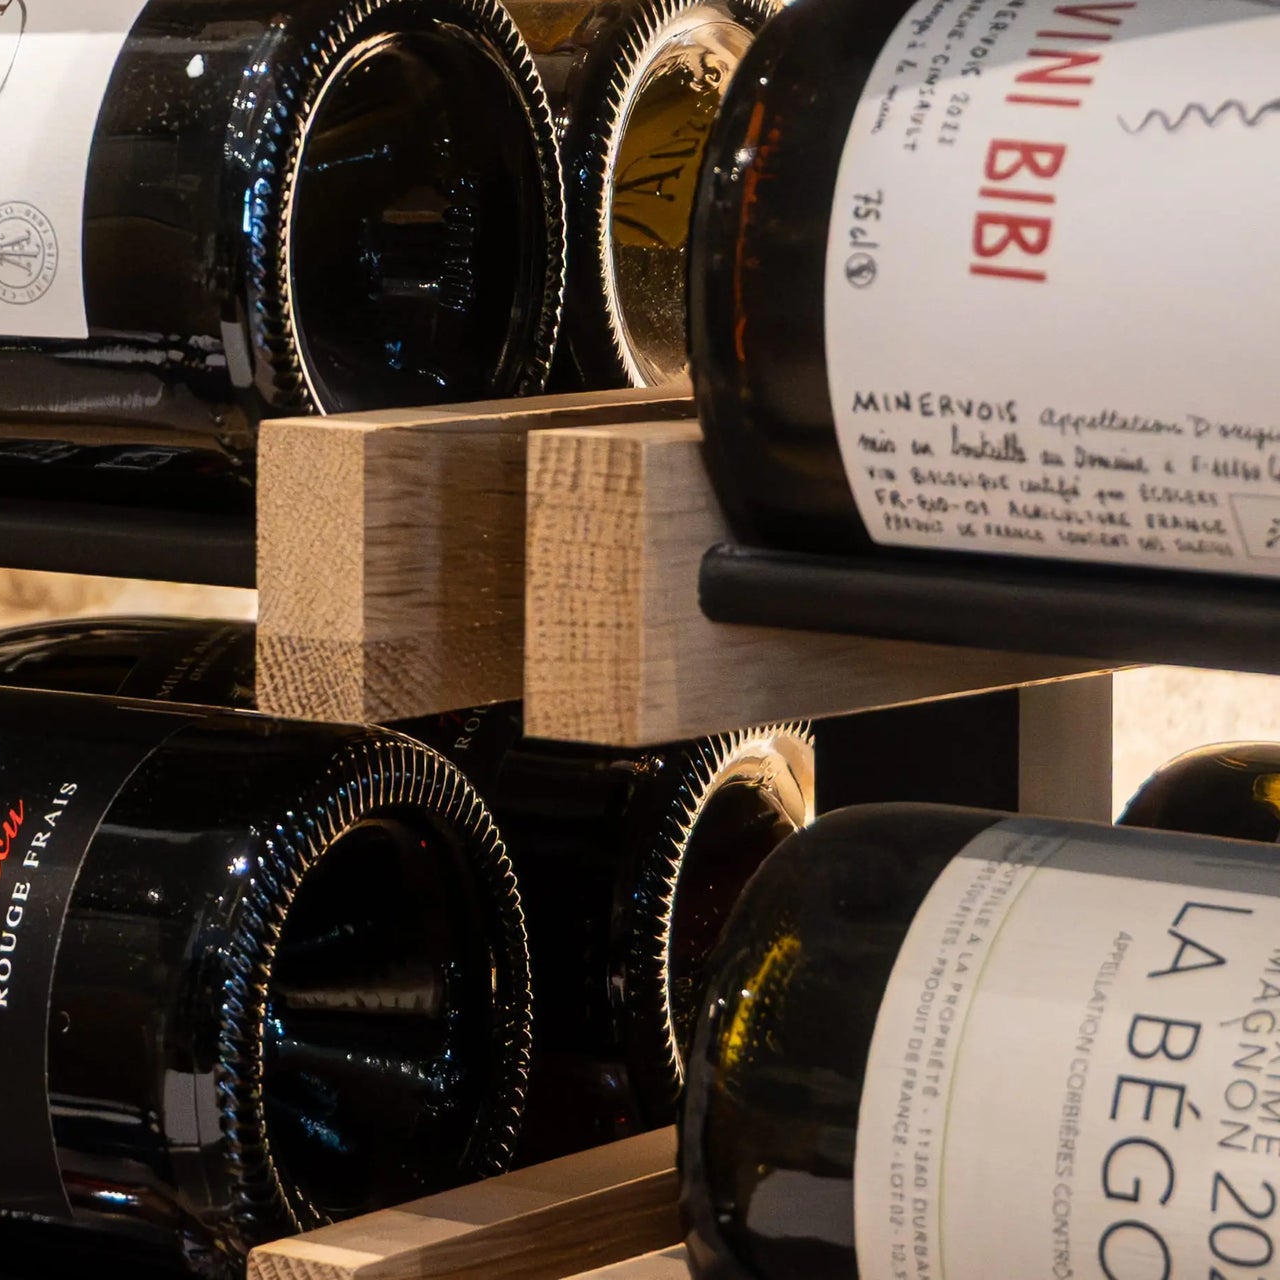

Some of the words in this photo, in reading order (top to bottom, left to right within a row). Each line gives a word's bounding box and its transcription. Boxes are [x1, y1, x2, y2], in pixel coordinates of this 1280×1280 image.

[1005, 1, 1138, 109] VINI
[968, 138, 1067, 283] BIBI
[852, 391, 1017, 424] MINERVOIS
[22, 782, 78, 869] FRAIS
[1075, 930, 1134, 1053] APPELLATION
[1146, 900, 1254, 978] LA
[1097, 1013, 1203, 1280] BÉGO
[1208, 1170, 1277, 1280] 20
